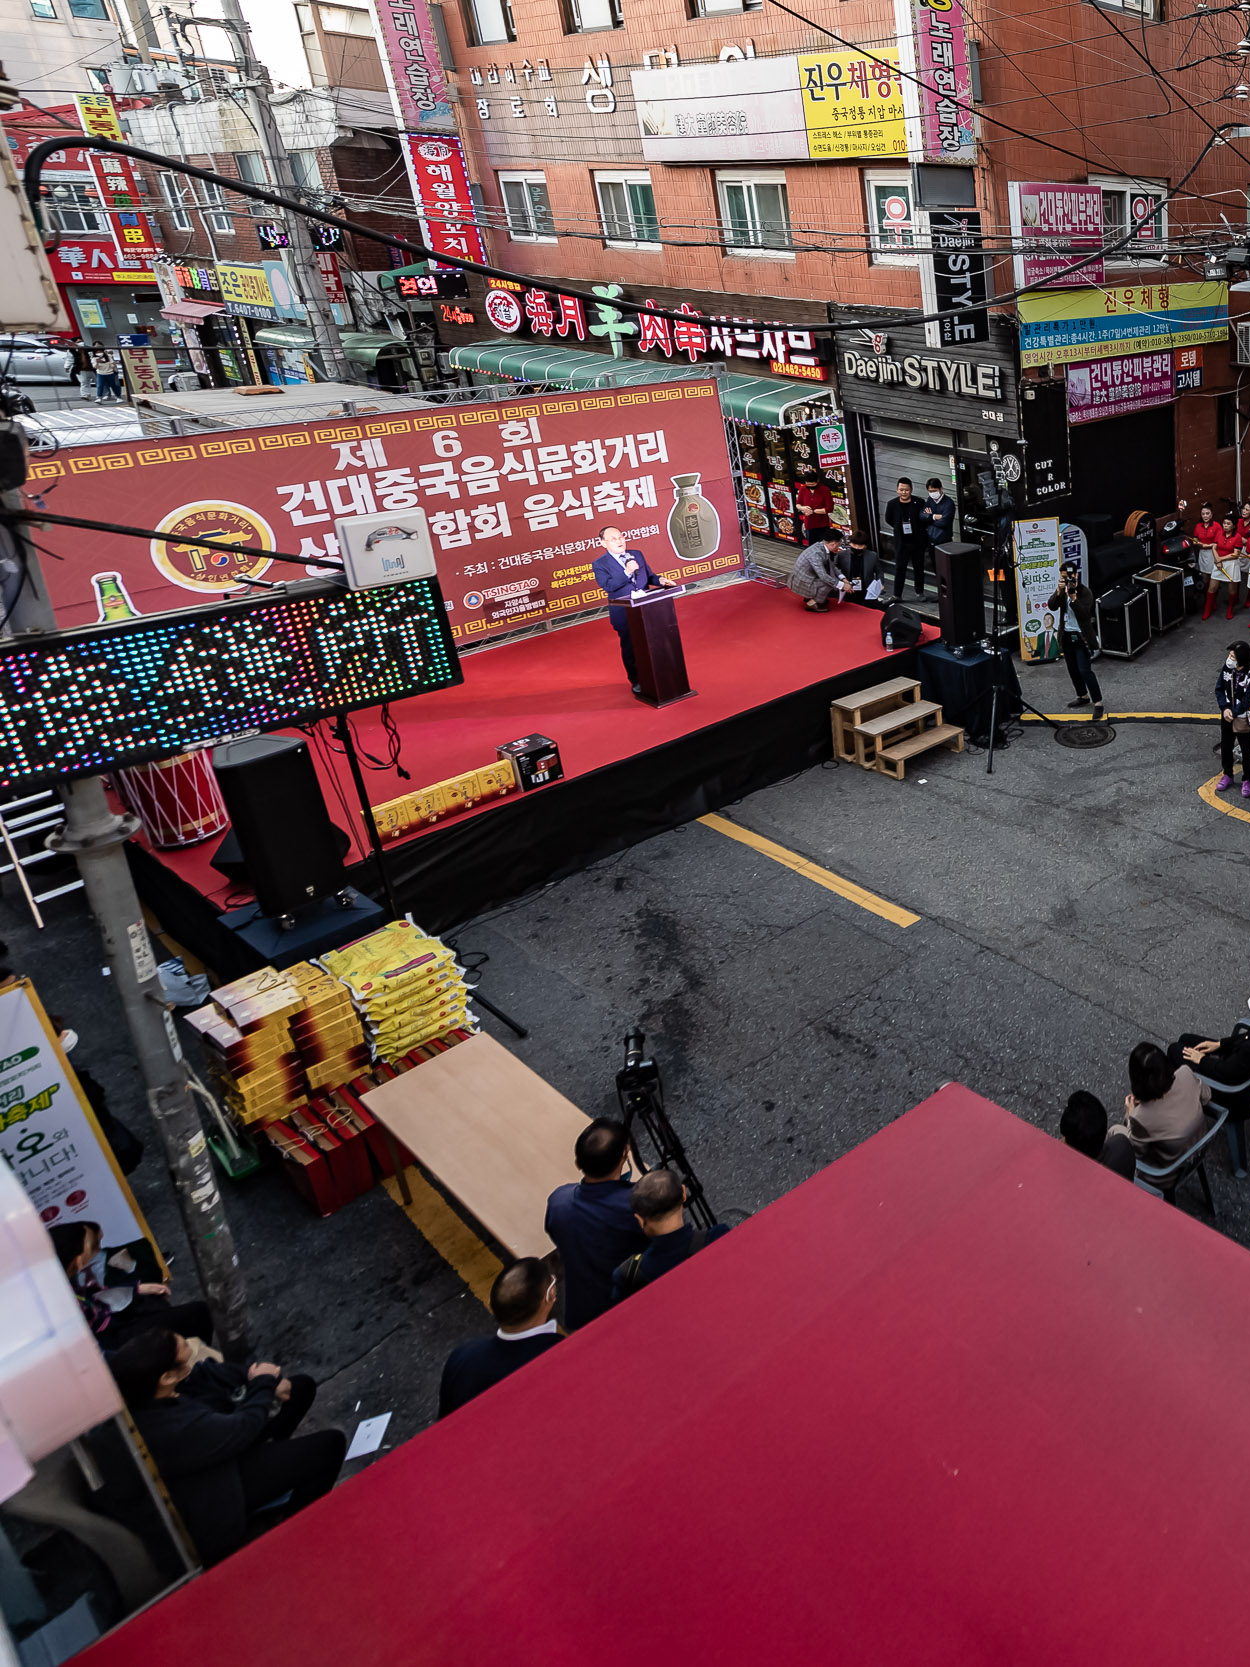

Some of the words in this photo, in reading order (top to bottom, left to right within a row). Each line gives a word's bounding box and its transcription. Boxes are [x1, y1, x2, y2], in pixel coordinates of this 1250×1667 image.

[929, 11, 962, 152] 노래연습장
[219, 270, 243, 298] 조은
[227, 304, 272, 319] T.6407-0100
[1104, 287, 1170, 313] 진우체형
[772, 361, 821, 379] 02)462-5450
[1024, 350, 1054, 365] 영업시간
[1090, 353, 1171, 388] 건대동안피부관리
[843, 351, 901, 383] Daejin
[903, 355, 1001, 400] STYLE
[981, 409, 1004, 422] 건대점
[331, 437, 389, 471] 제
[432, 430, 463, 458] 6
[498, 416, 542, 448] 회
[276, 429, 670, 527] 건대중국음식문화거리
[1035, 460, 1054, 470] CUT
[1036, 482, 1067, 495] COLOR
[523, 474, 658, 533] 음식축제
[463, 561, 489, 578] 주최
[619, 524, 660, 543] 인연합회
[482, 577, 540, 599] TSINGTAO
